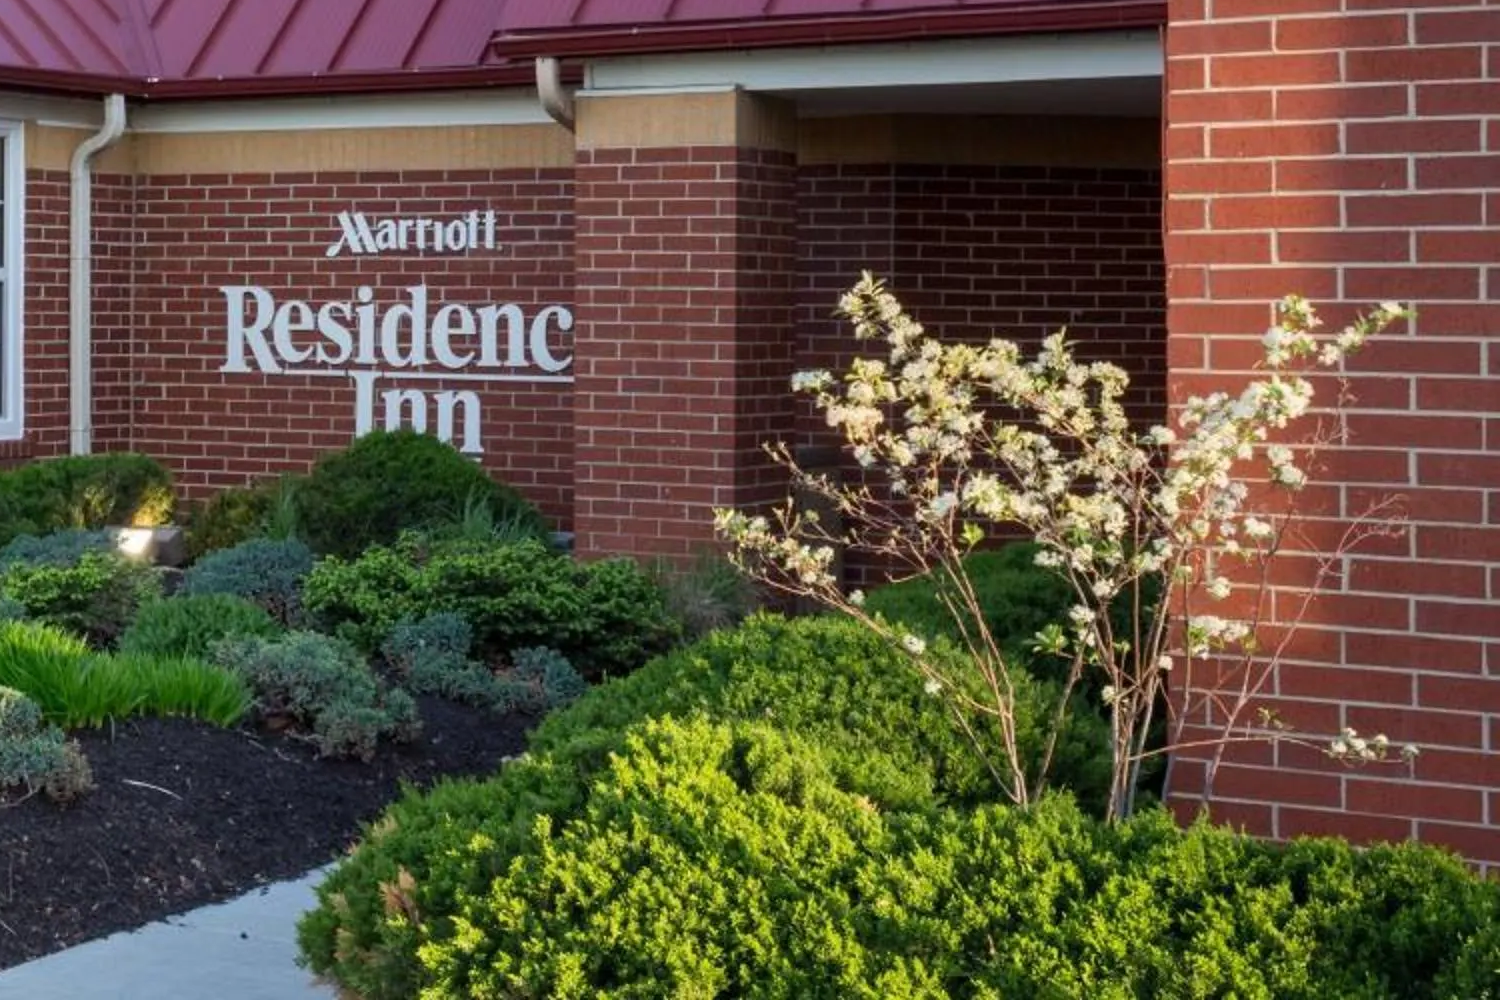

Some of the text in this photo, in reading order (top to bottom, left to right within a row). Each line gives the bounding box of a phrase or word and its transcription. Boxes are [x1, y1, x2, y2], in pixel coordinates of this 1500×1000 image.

[326, 209, 497, 257] Marriott
[219, 283, 574, 374] Residenc
[348, 370, 485, 454] Inn
